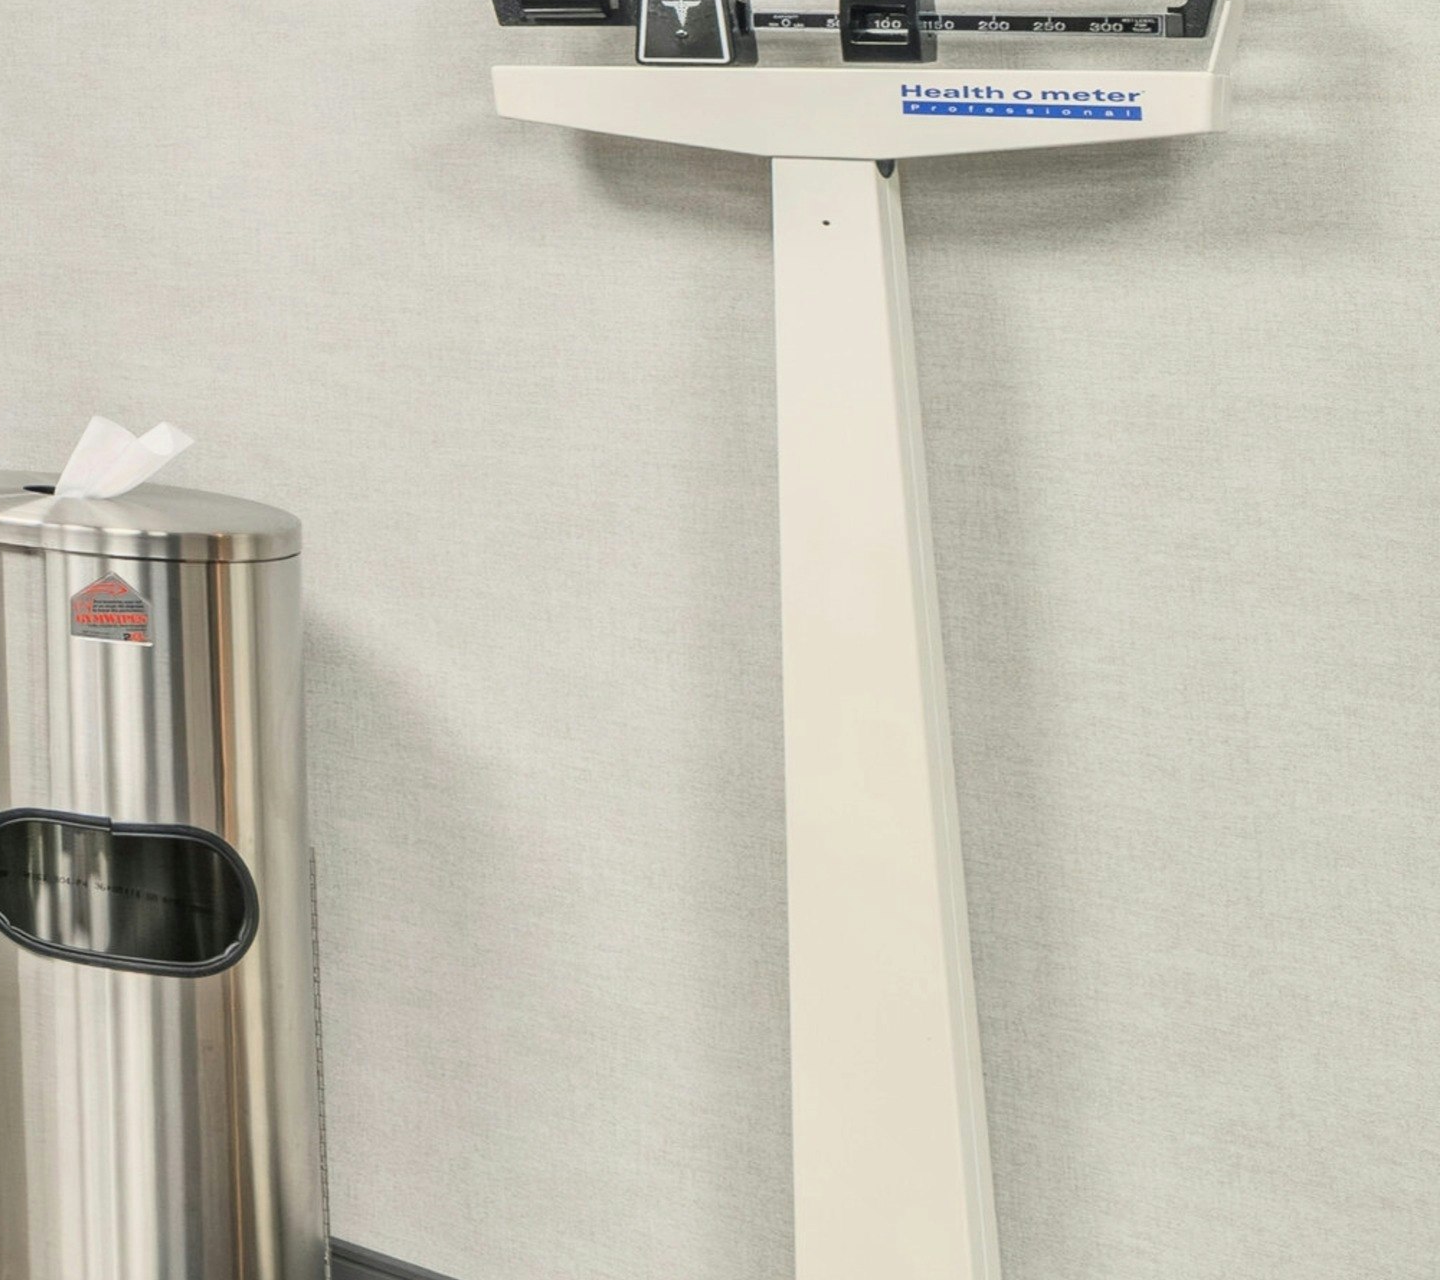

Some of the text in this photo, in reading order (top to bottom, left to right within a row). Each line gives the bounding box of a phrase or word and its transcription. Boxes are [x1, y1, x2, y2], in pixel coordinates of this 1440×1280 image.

[874, 19, 902, 30] 100
[978, 21, 1010, 32] 200
[1033, 21, 1066, 32] 250
[1089, 22, 1124, 33] 300
[900, 84, 1004, 100] Health
[1041, 89, 1142, 102] meter
